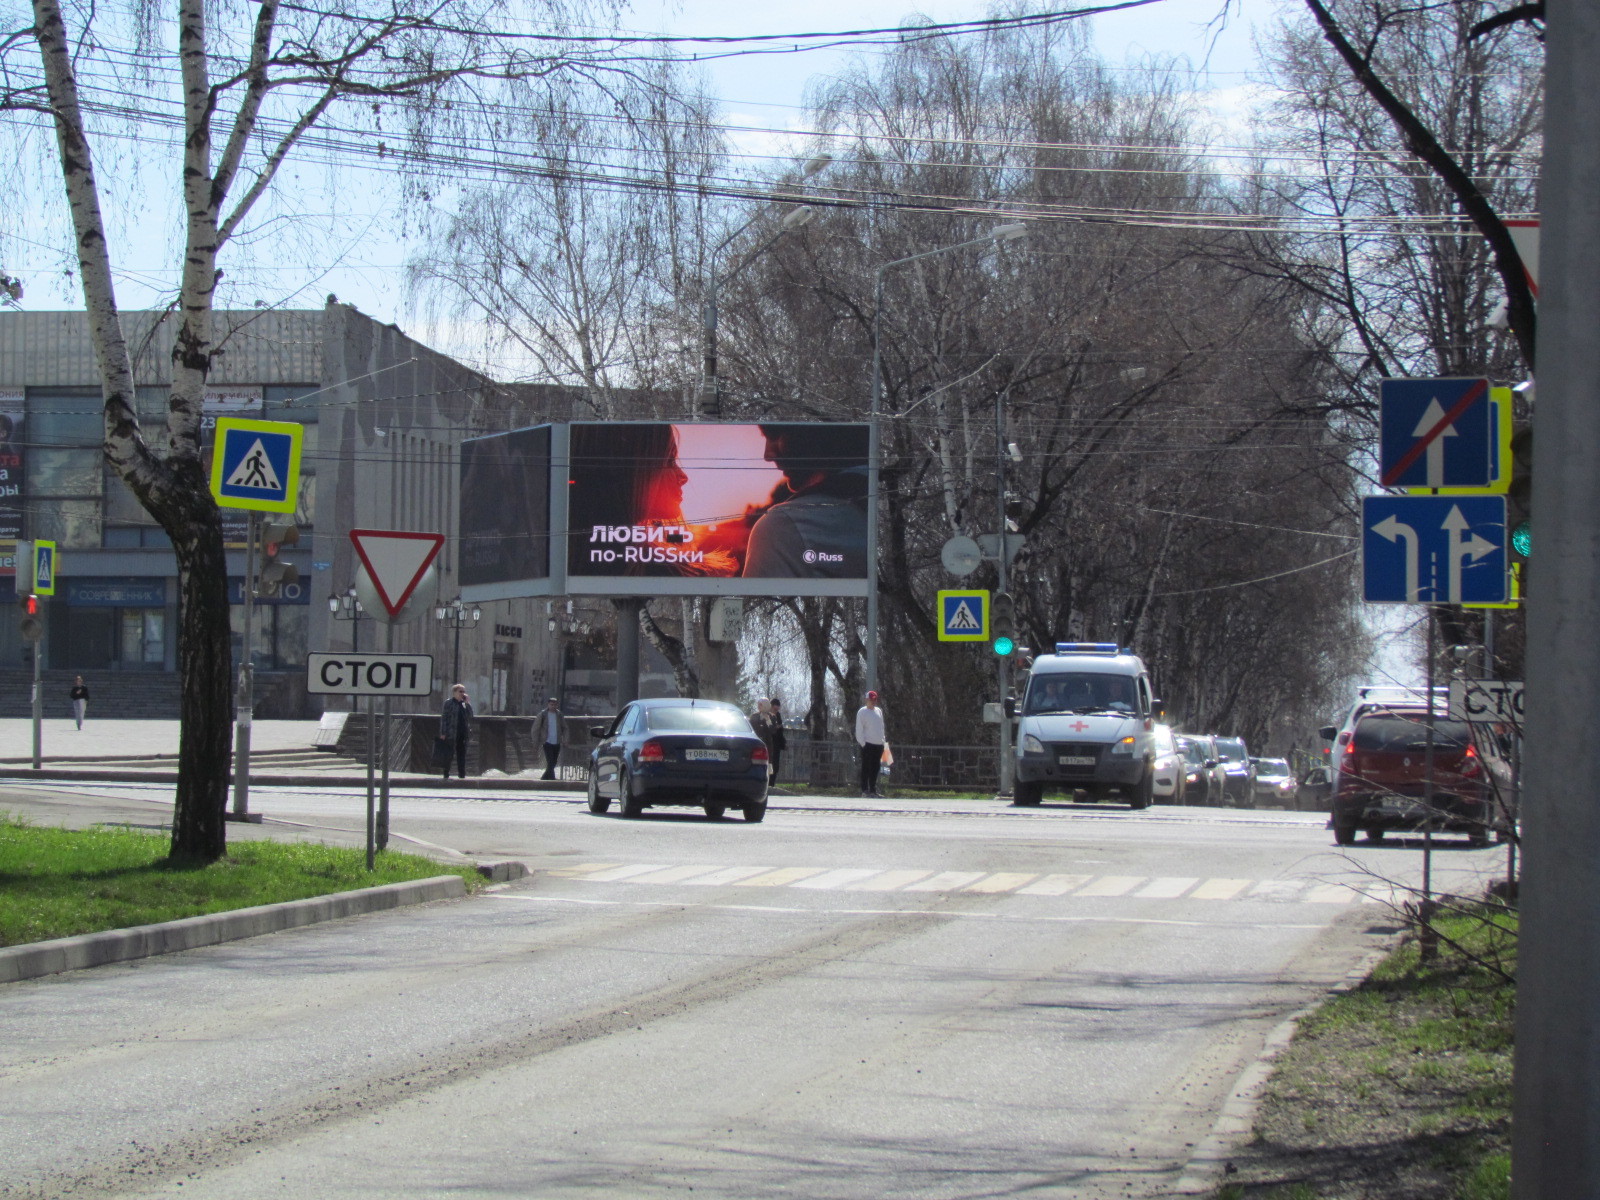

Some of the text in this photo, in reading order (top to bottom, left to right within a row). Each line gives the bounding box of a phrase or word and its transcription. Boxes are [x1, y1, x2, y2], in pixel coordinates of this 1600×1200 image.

[201, 416, 216, 429] 23
[590, 525, 694, 543] ЛЮБИТЬ
[590, 547, 704, 563] по-RUSSки
[818, 552, 844, 562] Russ
[321, 660, 417, 689] СТОП
